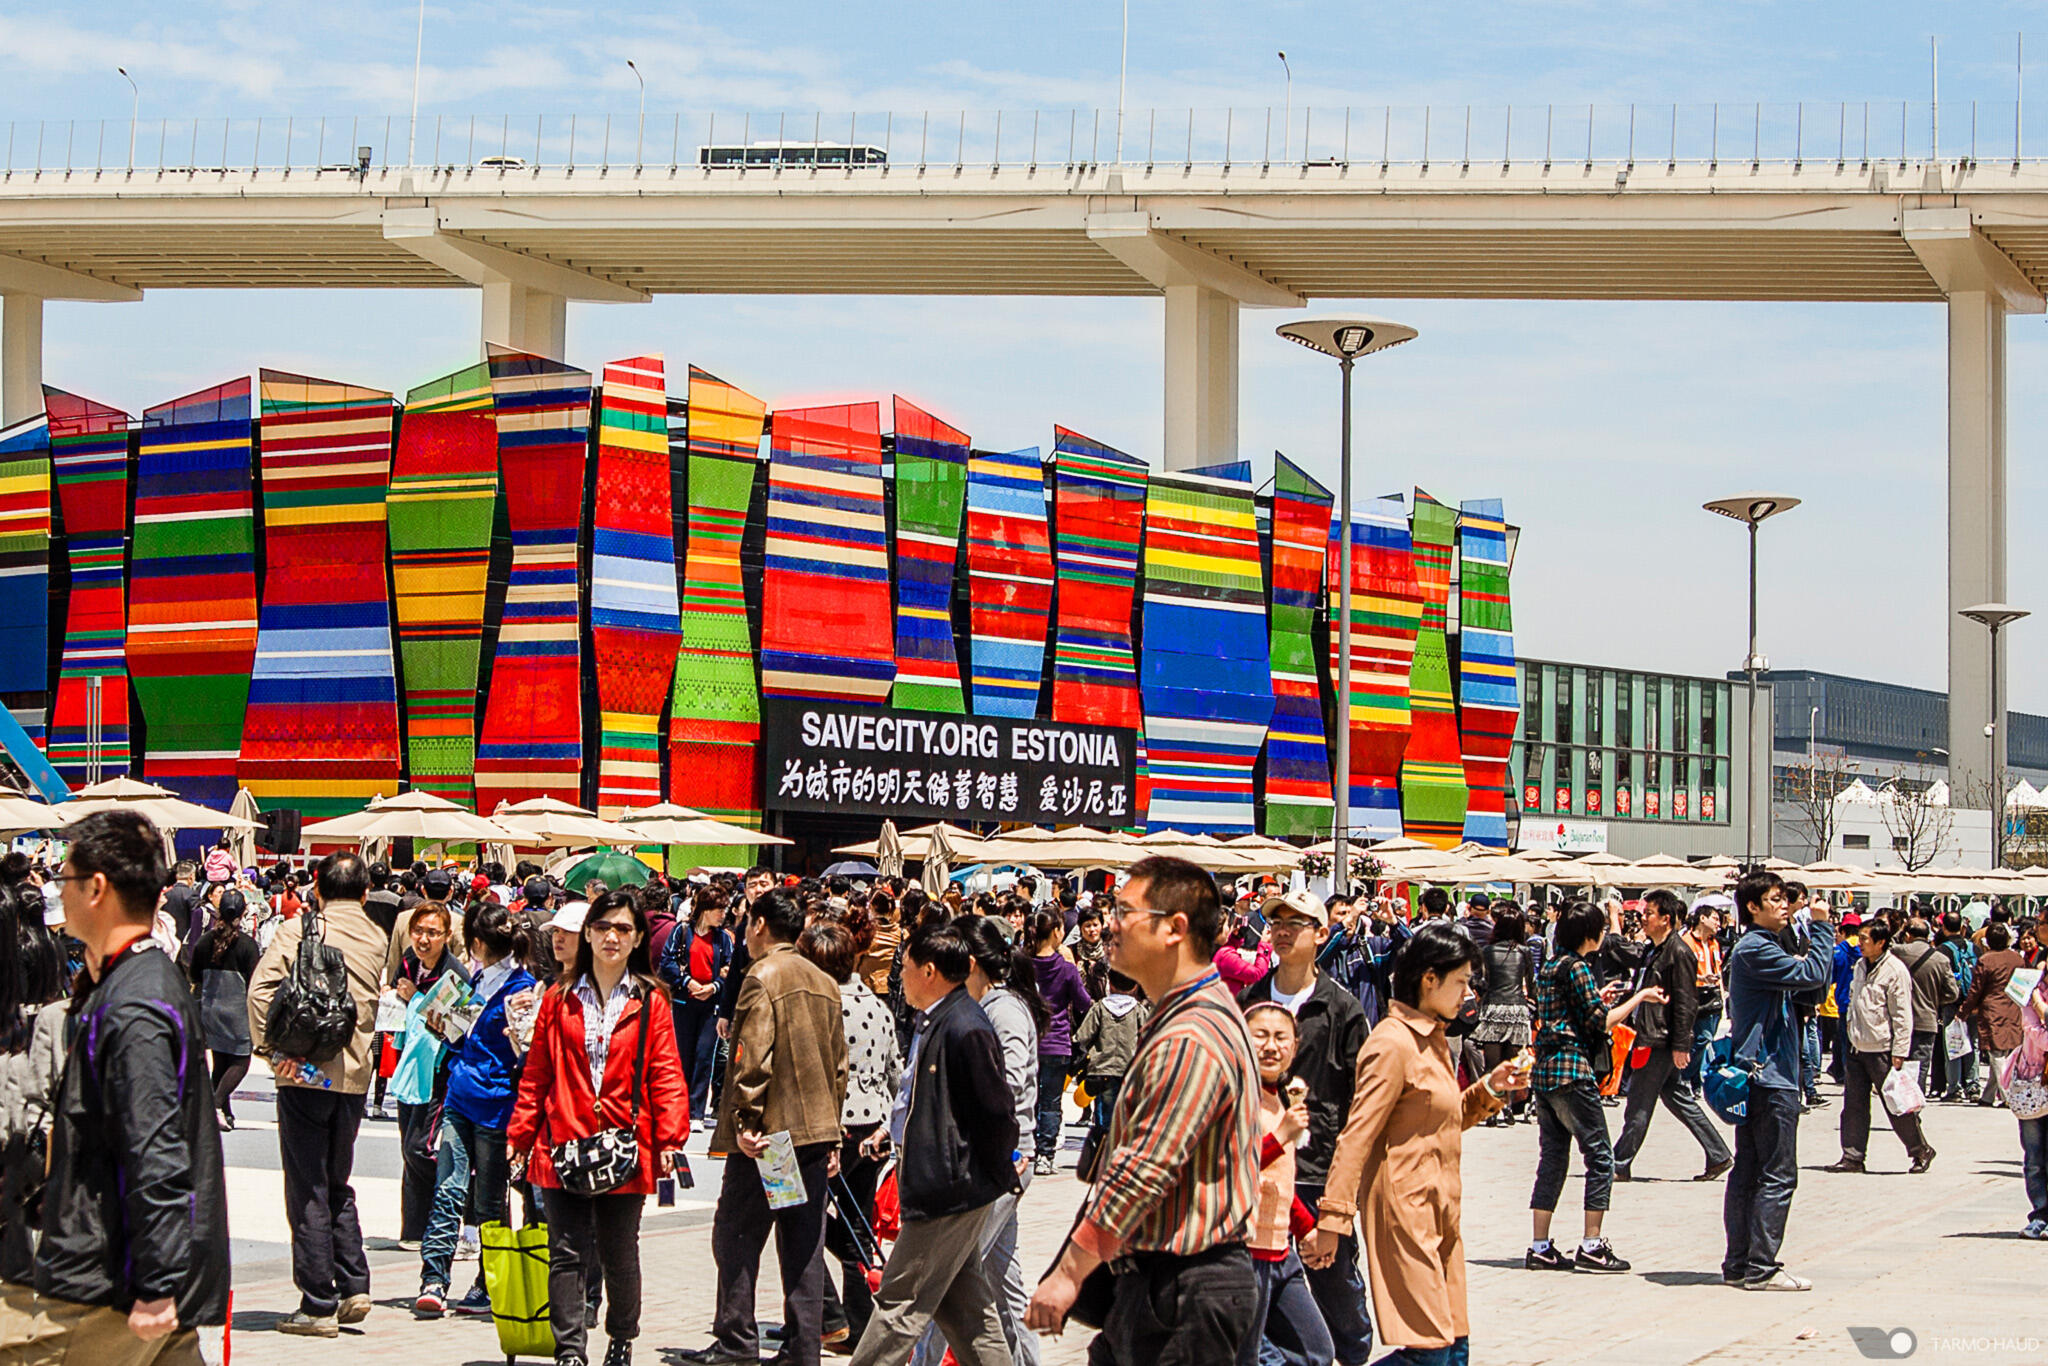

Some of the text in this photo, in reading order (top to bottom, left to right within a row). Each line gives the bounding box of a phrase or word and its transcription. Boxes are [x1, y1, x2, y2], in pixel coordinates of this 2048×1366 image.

[801, 711, 1120, 767] SAVECITY.ORG ESTONIA
[1039, 775, 1127, 816] 爱沙尼亚
